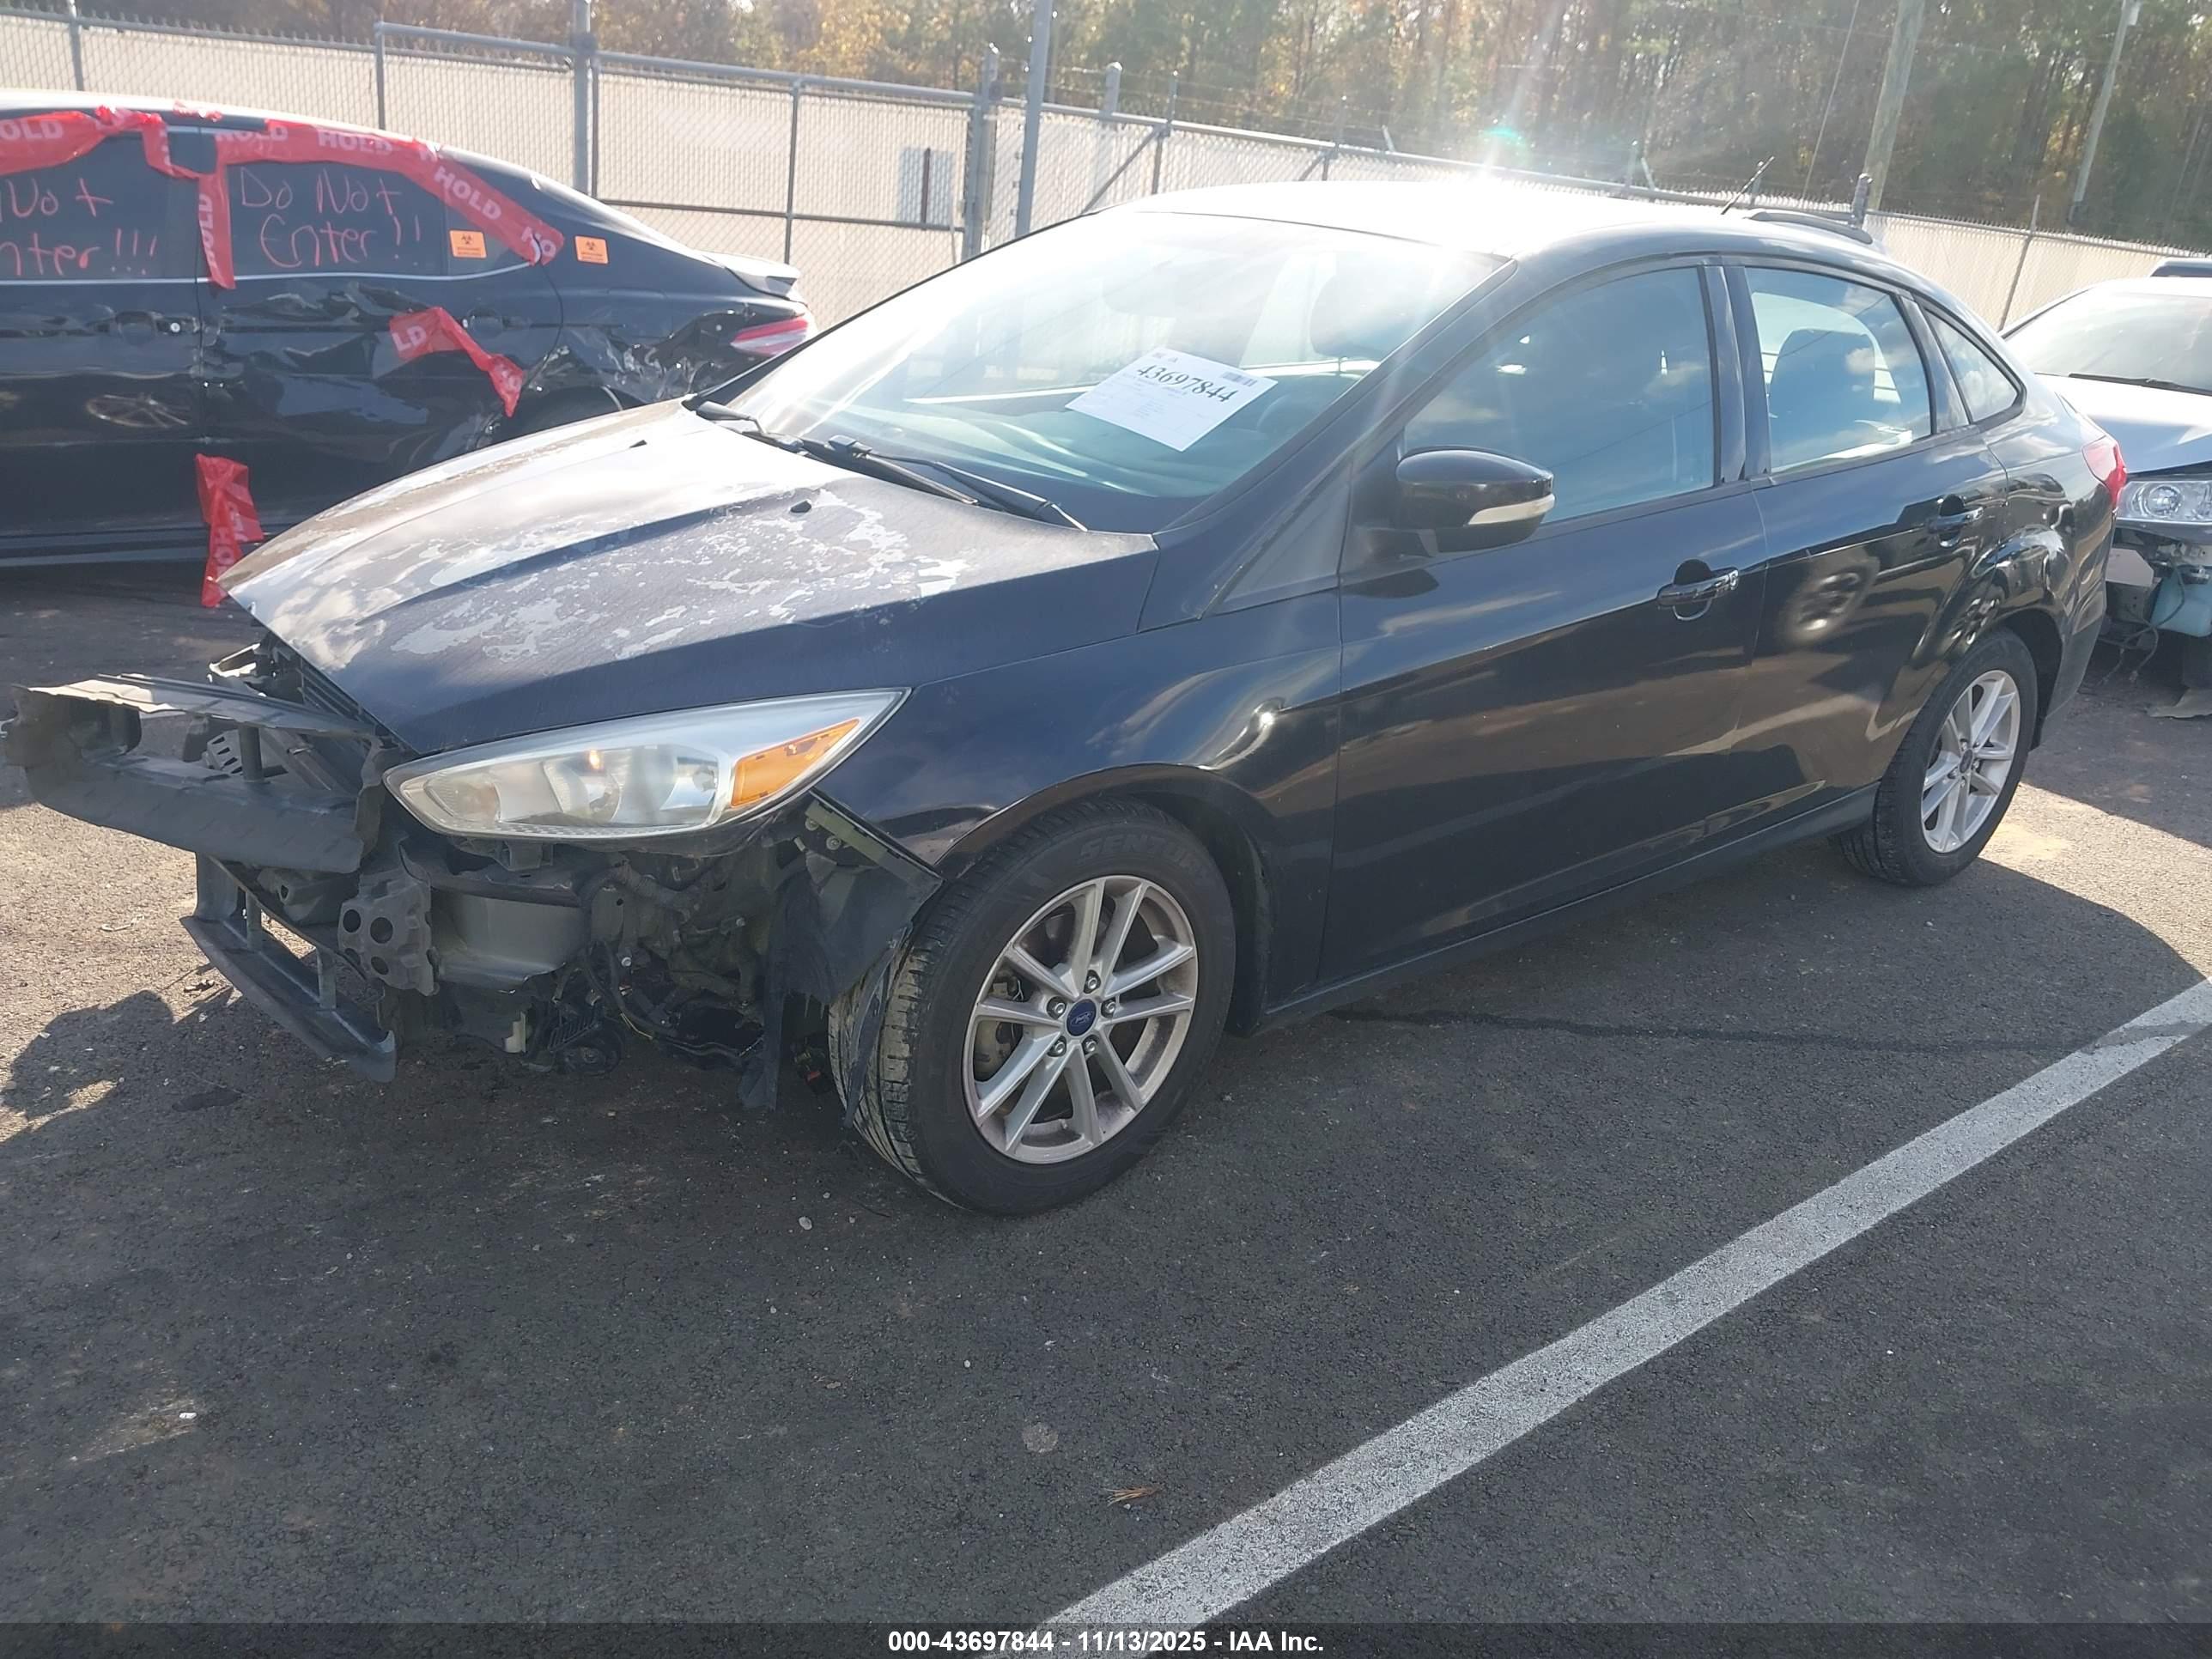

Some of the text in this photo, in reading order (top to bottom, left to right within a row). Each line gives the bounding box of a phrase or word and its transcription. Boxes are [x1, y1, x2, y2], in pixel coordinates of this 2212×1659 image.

[240, 167, 403, 216] Do Not
[432, 165, 502, 221] HOLD
[1136, 364, 1239, 403] 43697844
